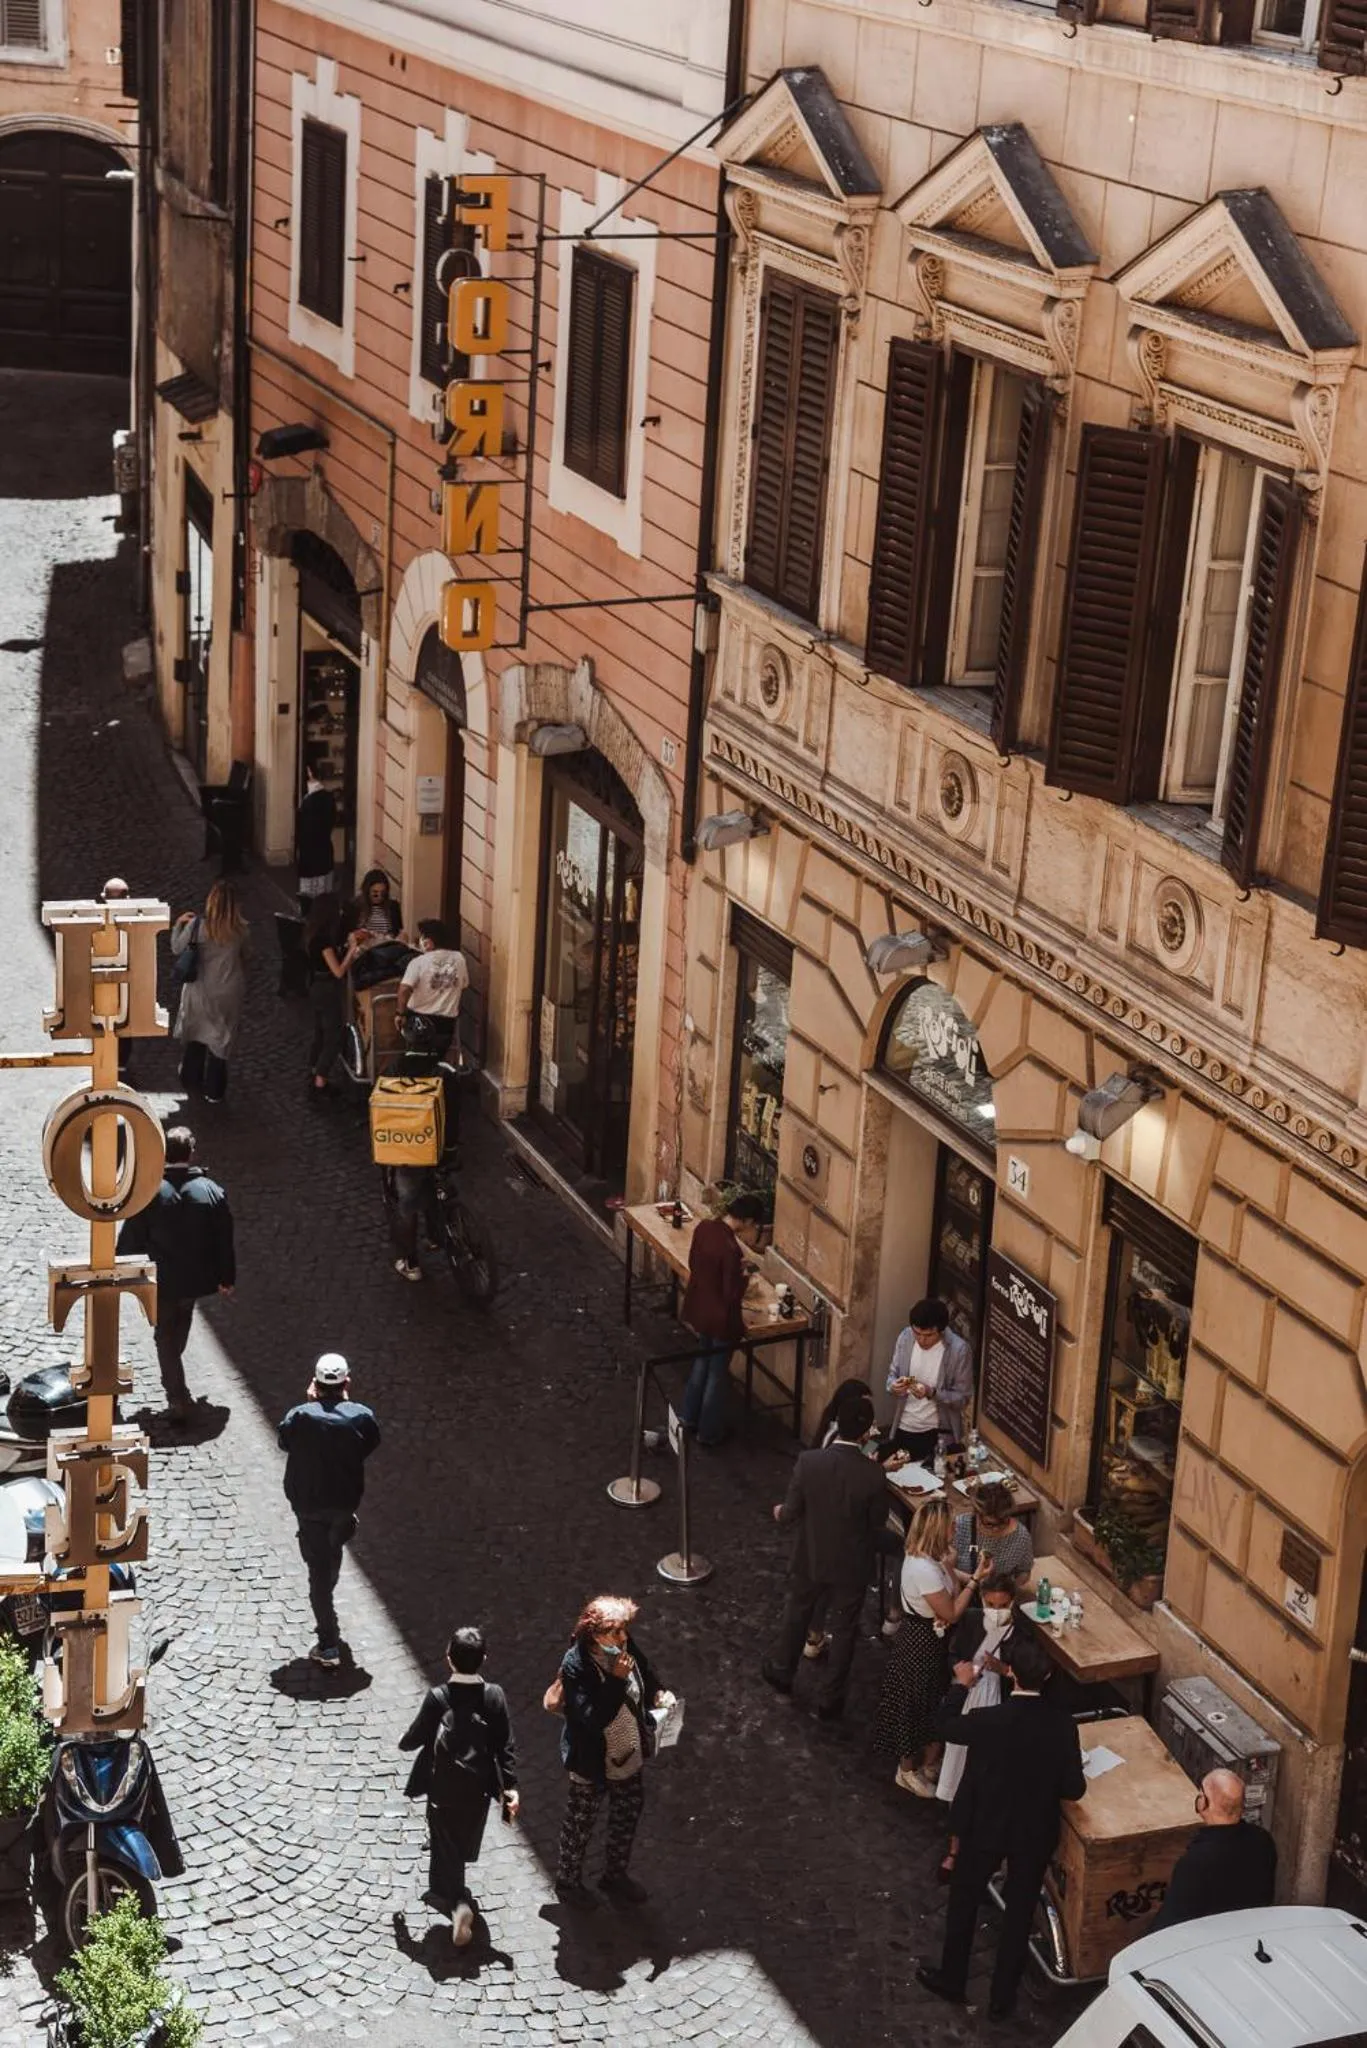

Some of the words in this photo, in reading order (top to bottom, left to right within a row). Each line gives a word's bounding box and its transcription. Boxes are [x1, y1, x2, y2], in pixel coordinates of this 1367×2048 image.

[374, 1128, 426, 1146] Glovo
[1010, 1160, 1027, 1192] 34
[42, 898, 171, 1735] HOTEL
